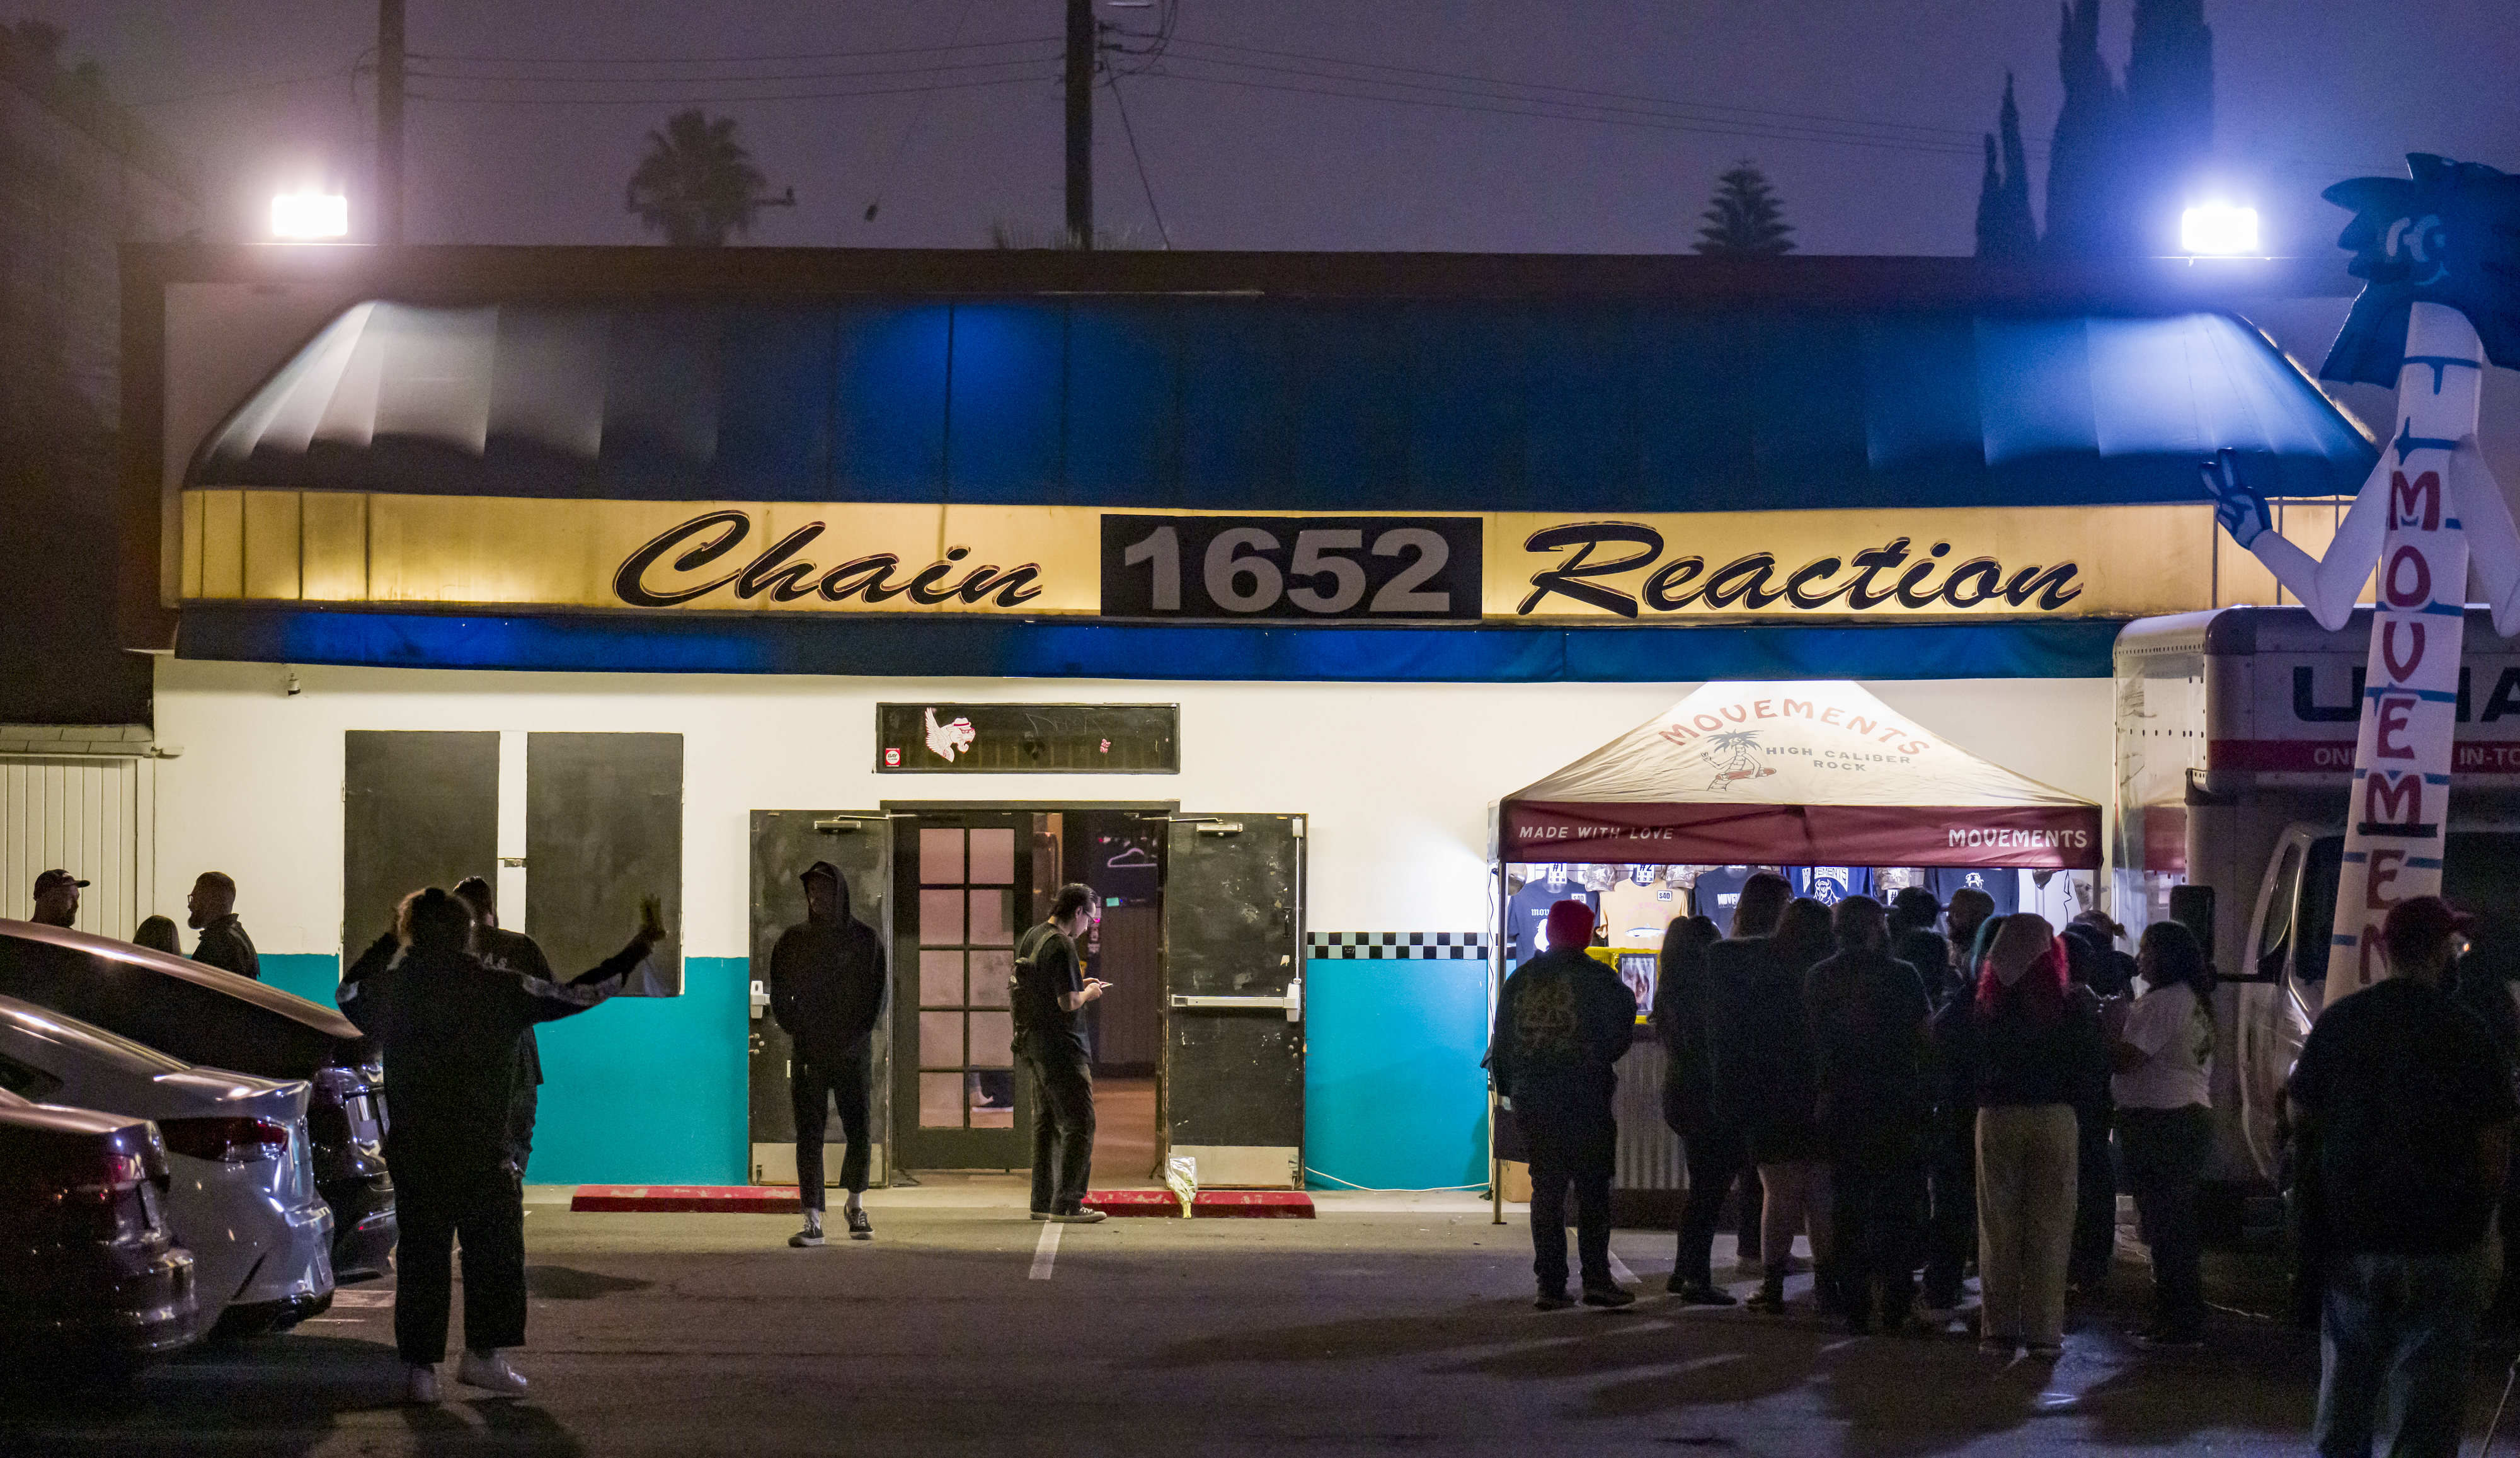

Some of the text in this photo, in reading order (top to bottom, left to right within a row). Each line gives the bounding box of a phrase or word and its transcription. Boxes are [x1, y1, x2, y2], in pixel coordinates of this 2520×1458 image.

[612, 509, 2084, 619] Chain Reaction
[1125, 525, 1450, 613] 1652
[1658, 698, 1930, 755] MOVEMENTS
[1766, 746, 1910, 764] HIGH CALIBER
[1813, 759, 1865, 772] ROCK
[1519, 826, 1674, 839] MADE WITH LOVE
[1949, 829, 2087, 848] MOVEMENTS
